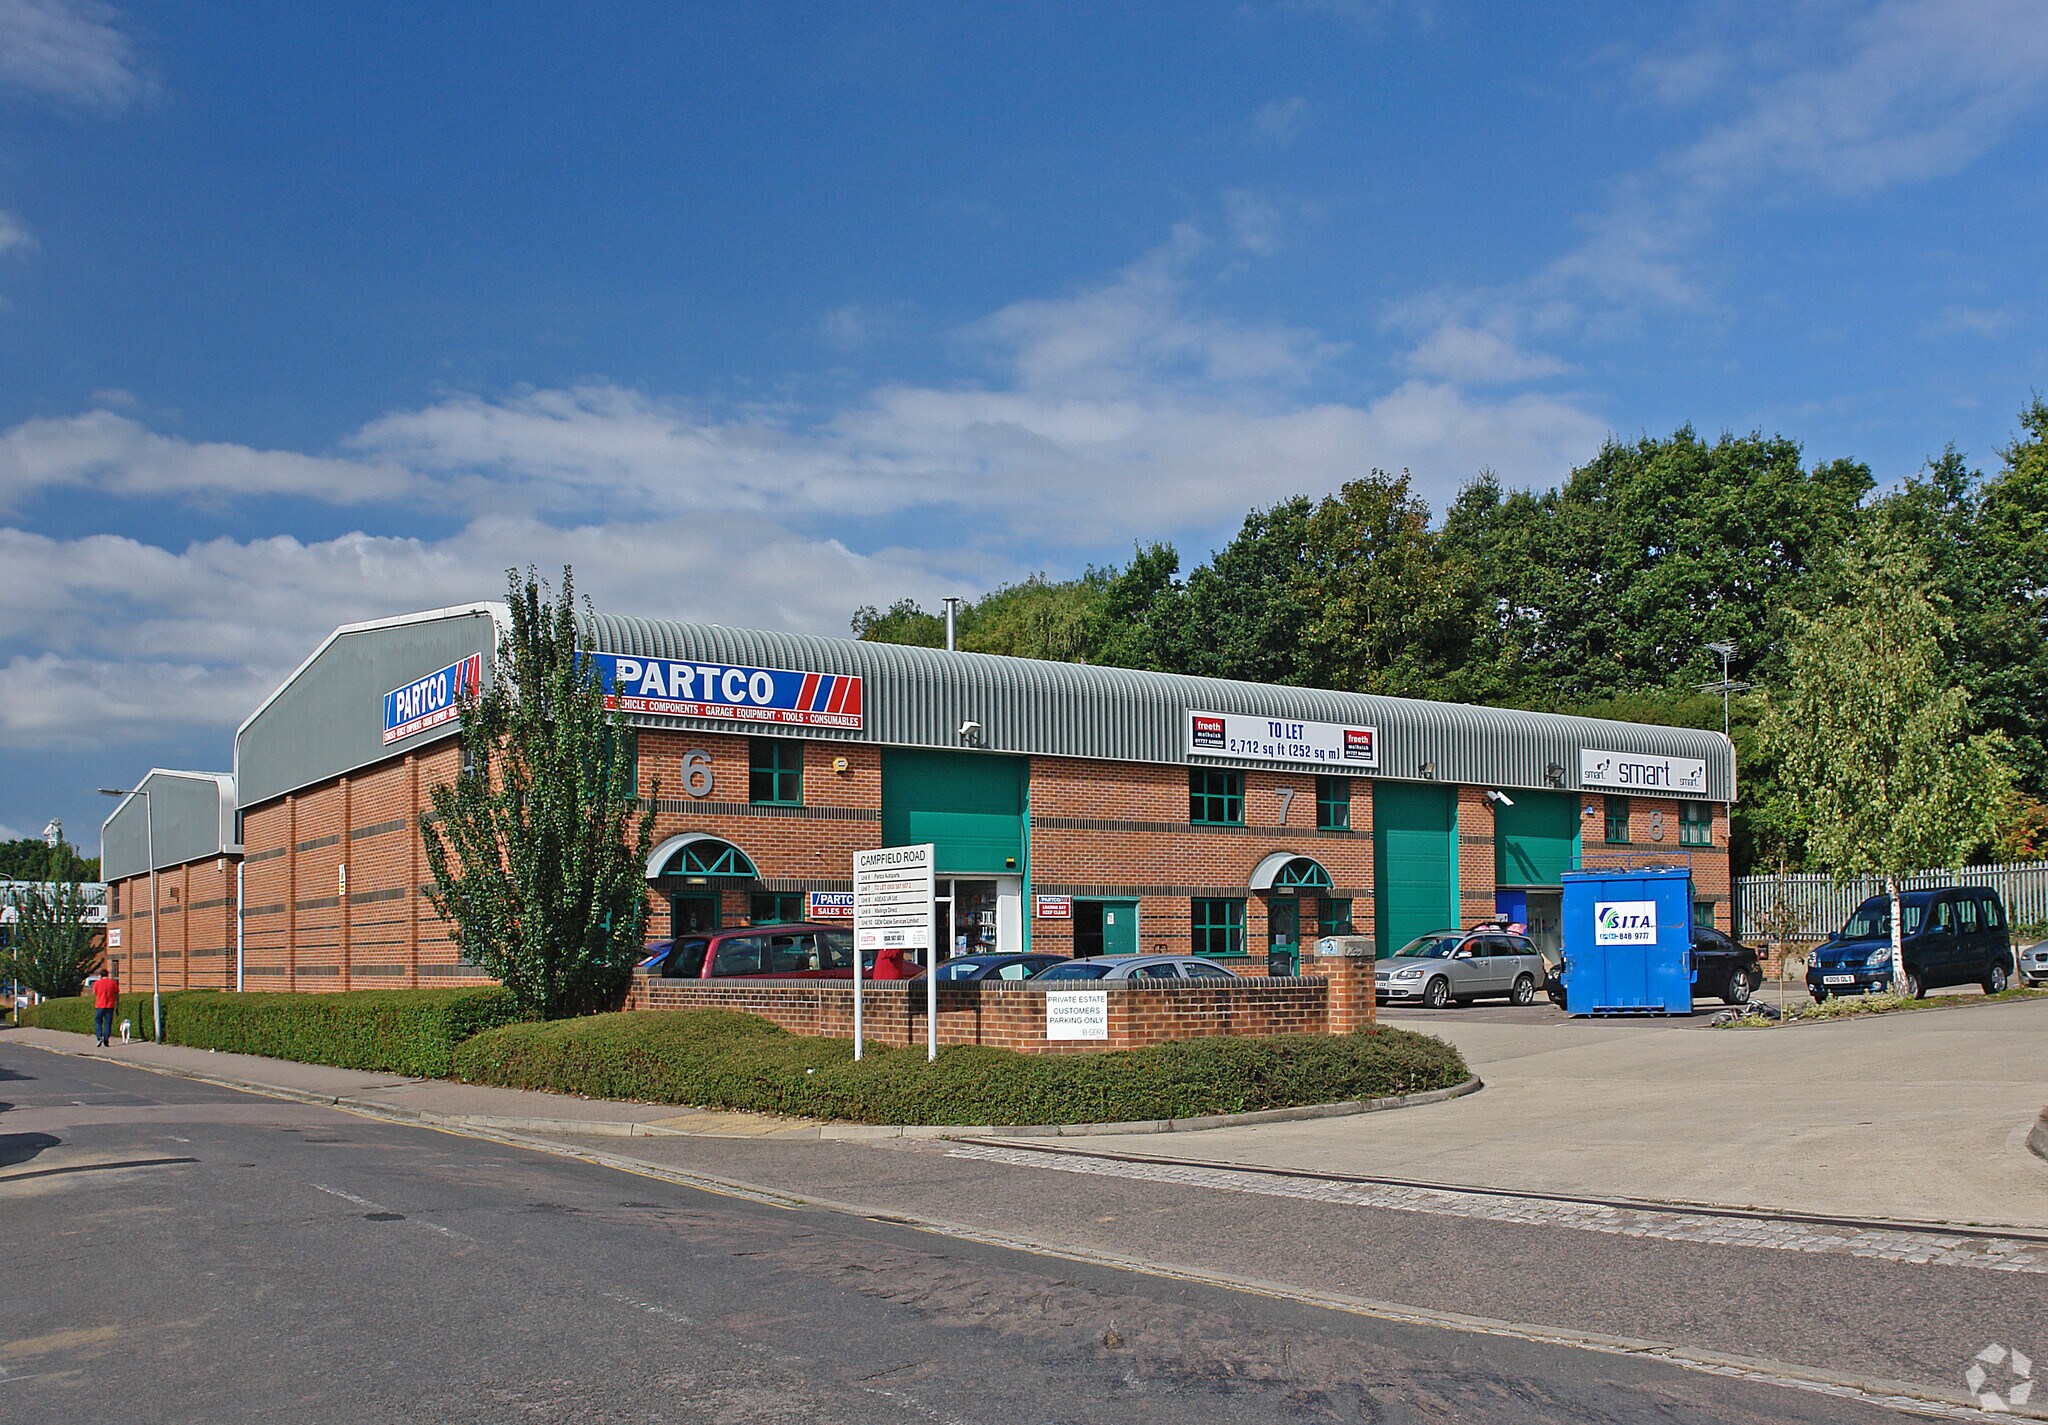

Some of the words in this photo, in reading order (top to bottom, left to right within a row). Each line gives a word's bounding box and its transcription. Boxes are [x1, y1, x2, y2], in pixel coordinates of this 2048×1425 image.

[616, 658, 774, 705] PARTCO
[396, 672, 447, 724] PARTCO
[619, 699, 646, 711] EHICLE
[649, 701, 698, 715] COMPONENTS
[705, 705, 734, 717] GARAGE
[737, 708, 776, 721] EQUIPMENT
[782, 712, 804, 723] TOOLS
[810, 713, 859, 727] CONSUMABLES
[1197, 721, 1221, 731] freeth
[1268, 722, 1282, 739] TO
[1286, 723, 1304, 740] LET
[1348, 734, 1369, 744] freeth
[1230, 739, 1259, 755] 2,712
[1262, 744, 1274, 758] sq
[1277, 742, 1285, 756] ft
[1288, 743, 1311, 758] (252
[1314, 748, 1325, 762] sq
[1328, 747, 1340, 760] m)
[680, 749, 713, 797] 6
[1619, 761, 1670, 787] smart
[1275, 787, 1294, 824] 7
[1649, 809, 1664, 841] 8
[860, 852, 902, 867] CAMPFIELD
[903, 850, 926, 862] ROAD
[817, 907, 840, 915] SALES
[842, 907, 854, 915] CO
[1079, 995, 1105, 1003] ESTATE
[1049, 1016, 1083, 1024] PARKING
[1084, 1016, 1104, 1024] ONLY
[1053, 1007, 1100, 1015] CUSTOMERS
